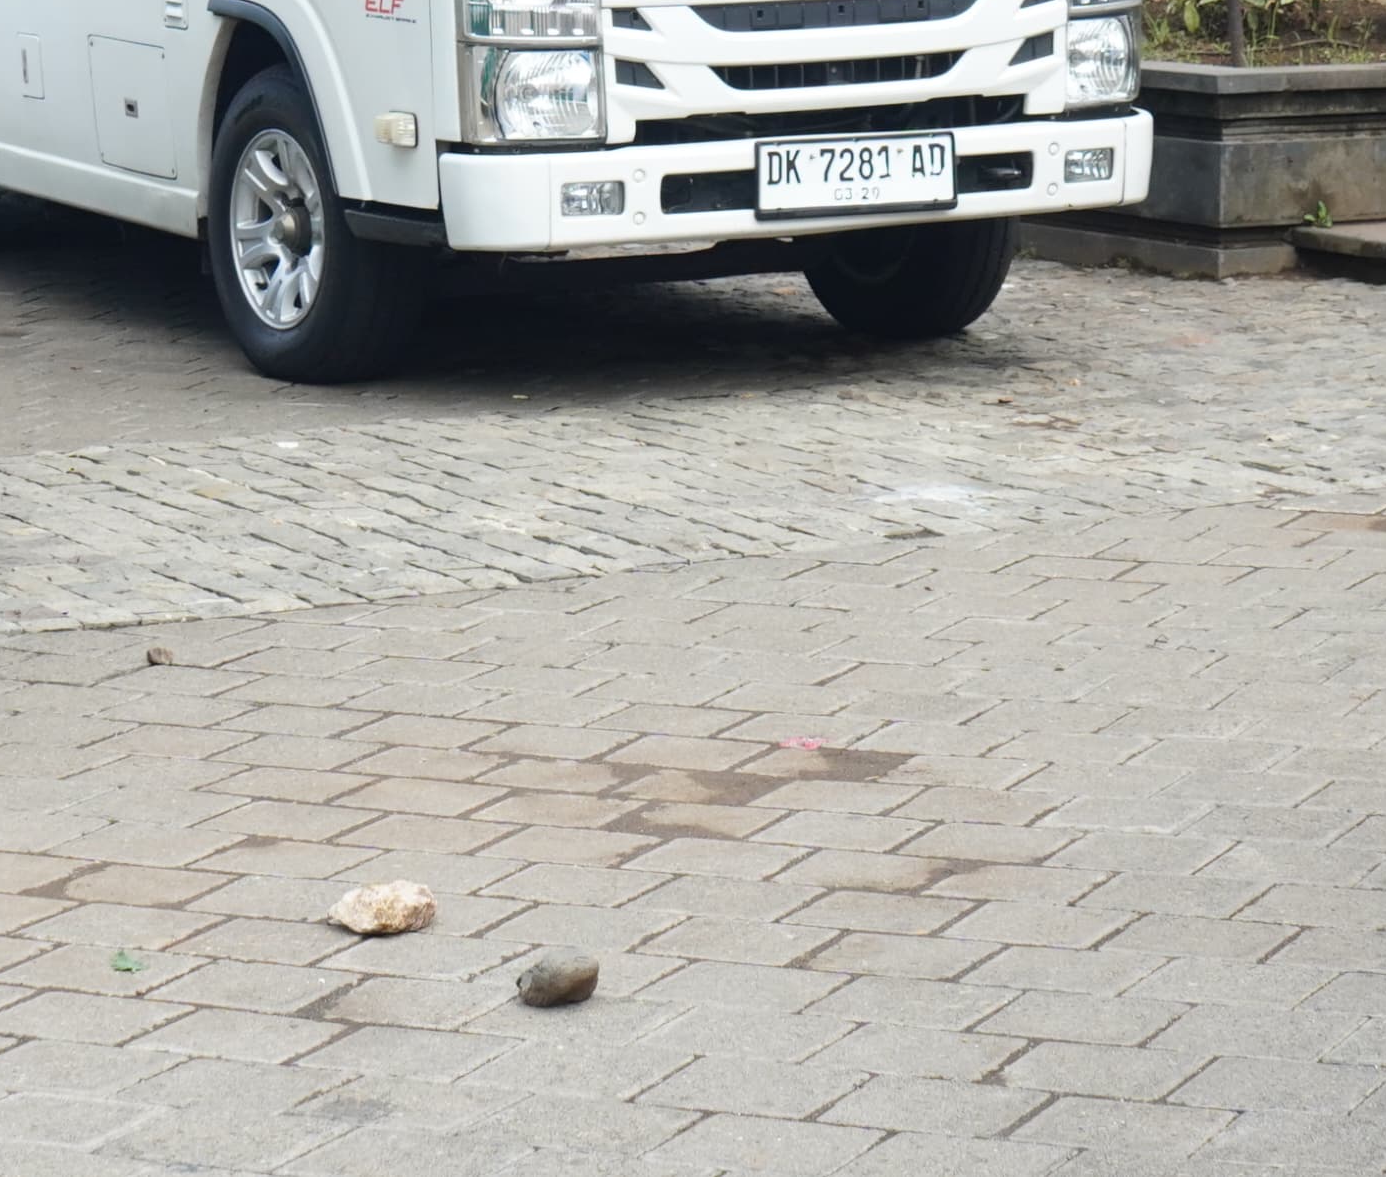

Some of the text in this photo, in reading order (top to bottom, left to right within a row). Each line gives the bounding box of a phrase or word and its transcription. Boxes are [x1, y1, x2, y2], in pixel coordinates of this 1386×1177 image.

[767, 142, 946, 185] DK 7281 AD
